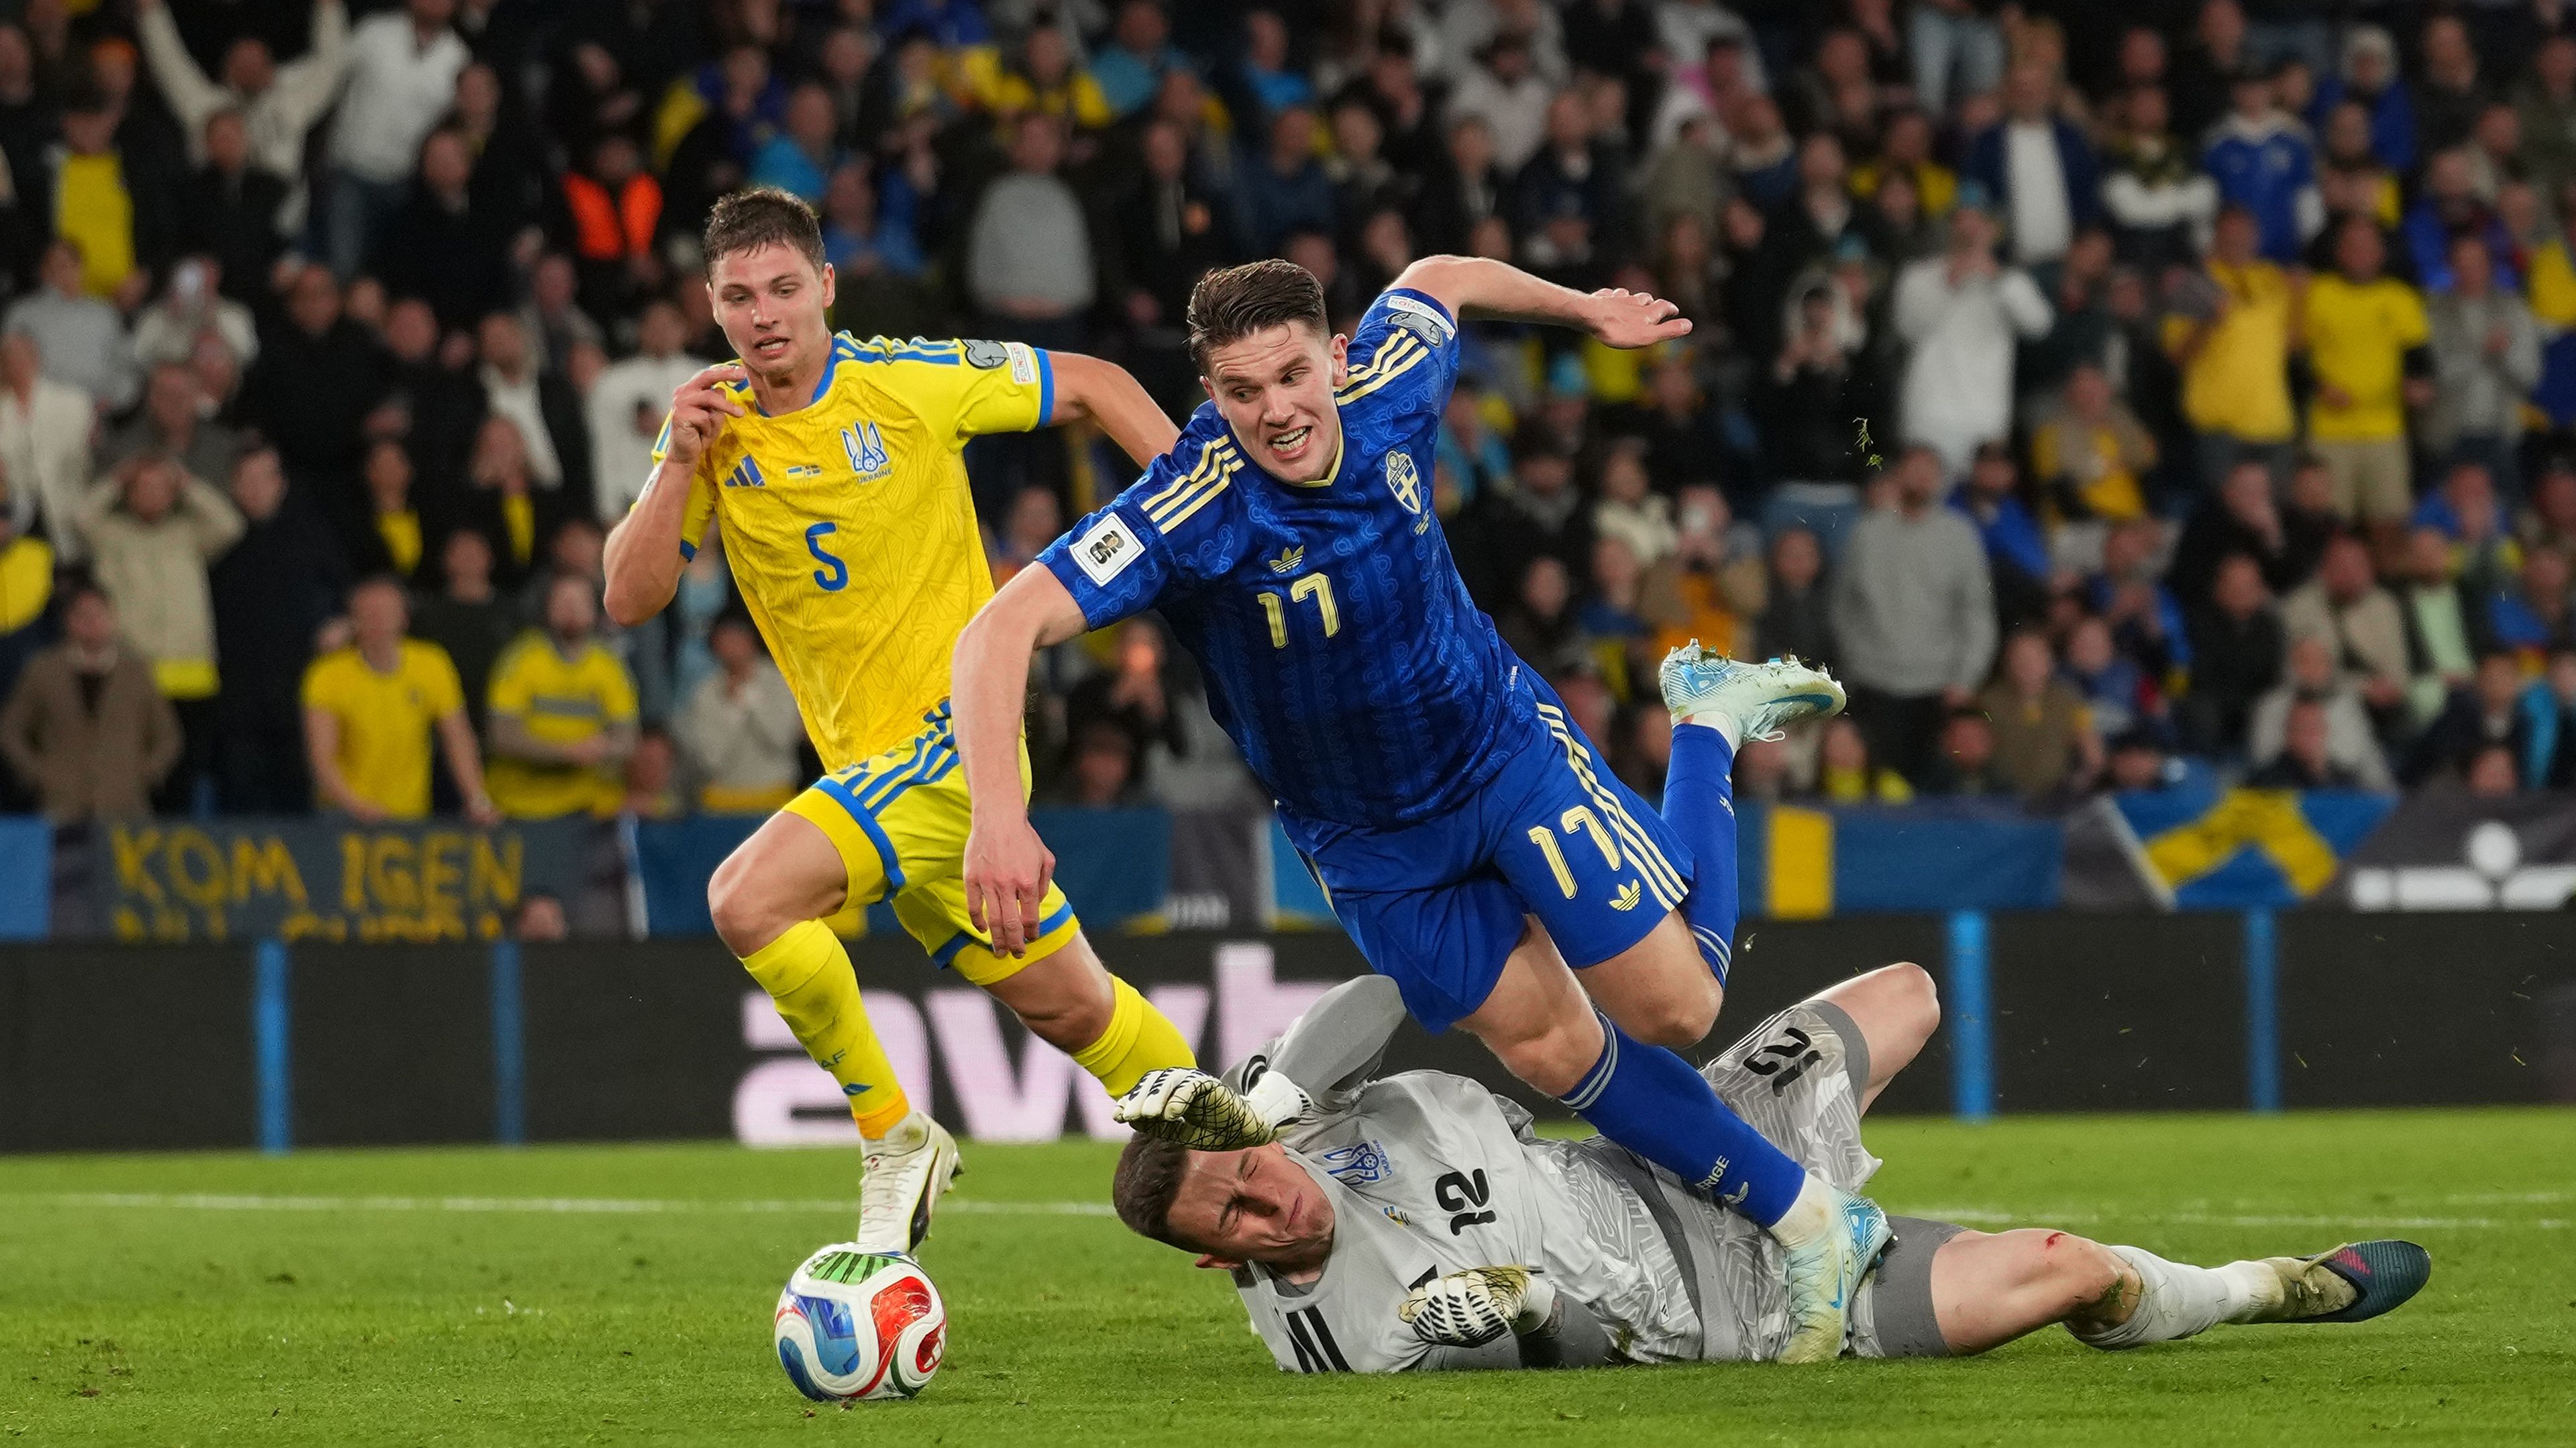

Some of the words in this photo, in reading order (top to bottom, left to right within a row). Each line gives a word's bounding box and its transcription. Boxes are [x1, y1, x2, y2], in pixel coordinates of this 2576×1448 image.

[856, 468, 893, 483] UKRAINE
[805, 521, 849, 591] 5
[1257, 572, 1341, 649] 17
[109, 824, 311, 909] KOM
[341, 829, 526, 911] IGEN
[1527, 805, 1621, 900] 17
[821, 1048, 847, 1068] AF
[1743, 1027, 1823, 1098] 12
[1372, 1139, 1393, 1176] UKRAINE
[1695, 1155, 1730, 1190] ERIGE
[1435, 1168, 1497, 1236] 12
